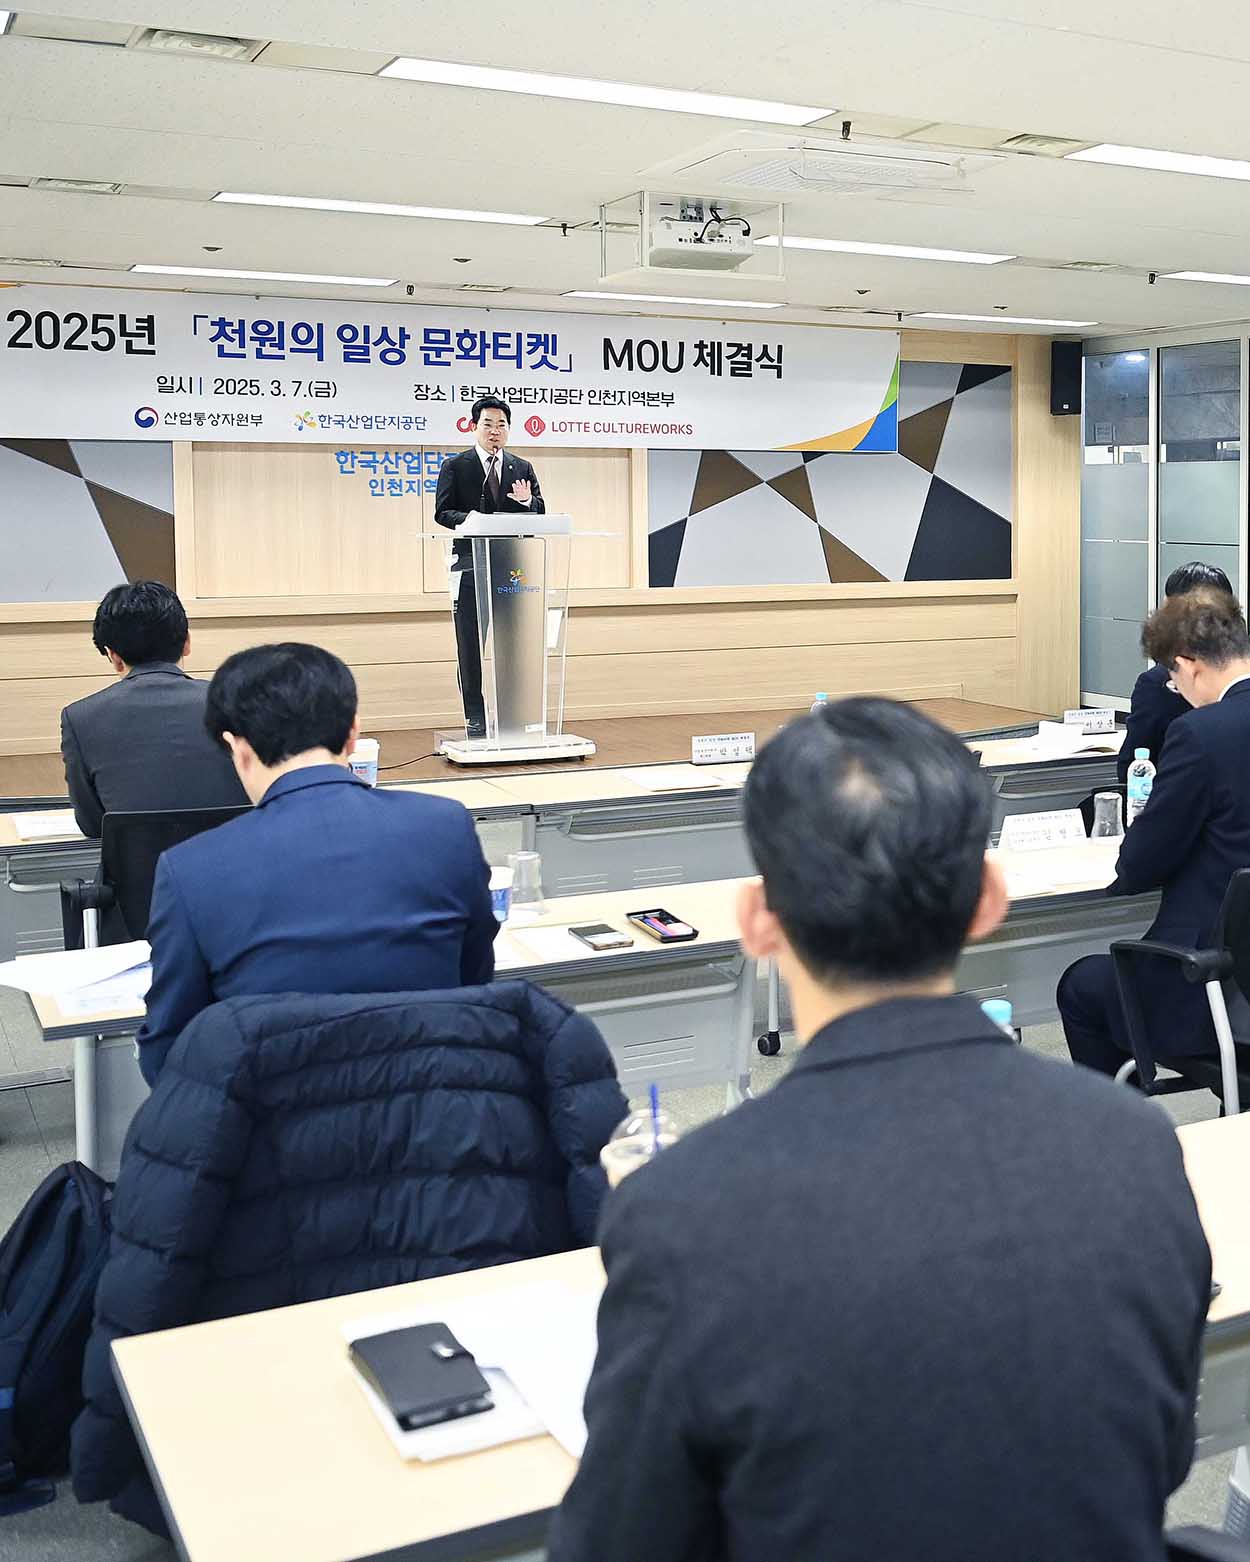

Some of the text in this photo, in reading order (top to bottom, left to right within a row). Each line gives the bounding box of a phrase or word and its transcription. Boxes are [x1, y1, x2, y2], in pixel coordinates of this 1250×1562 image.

[6, 309, 157, 356] 2025년
[336, 323, 409, 365] 일상
[603, 338, 685, 373] MOU
[693, 340, 783, 379] 체결식
[156, 376, 194, 395] 일시
[213, 378, 265, 396] 2025.
[271, 380, 287, 397] 3.
[413, 384, 447, 401] 장소
[587, 388, 675, 407] 인천지역본부
[164, 411, 263, 428] 산업통상자원부
[318, 413, 427, 431] 한국산업단지공단
[551, 421, 693, 436] LOTTE CULTUREWORKS
[335, 450, 459, 475] 한국산업단
